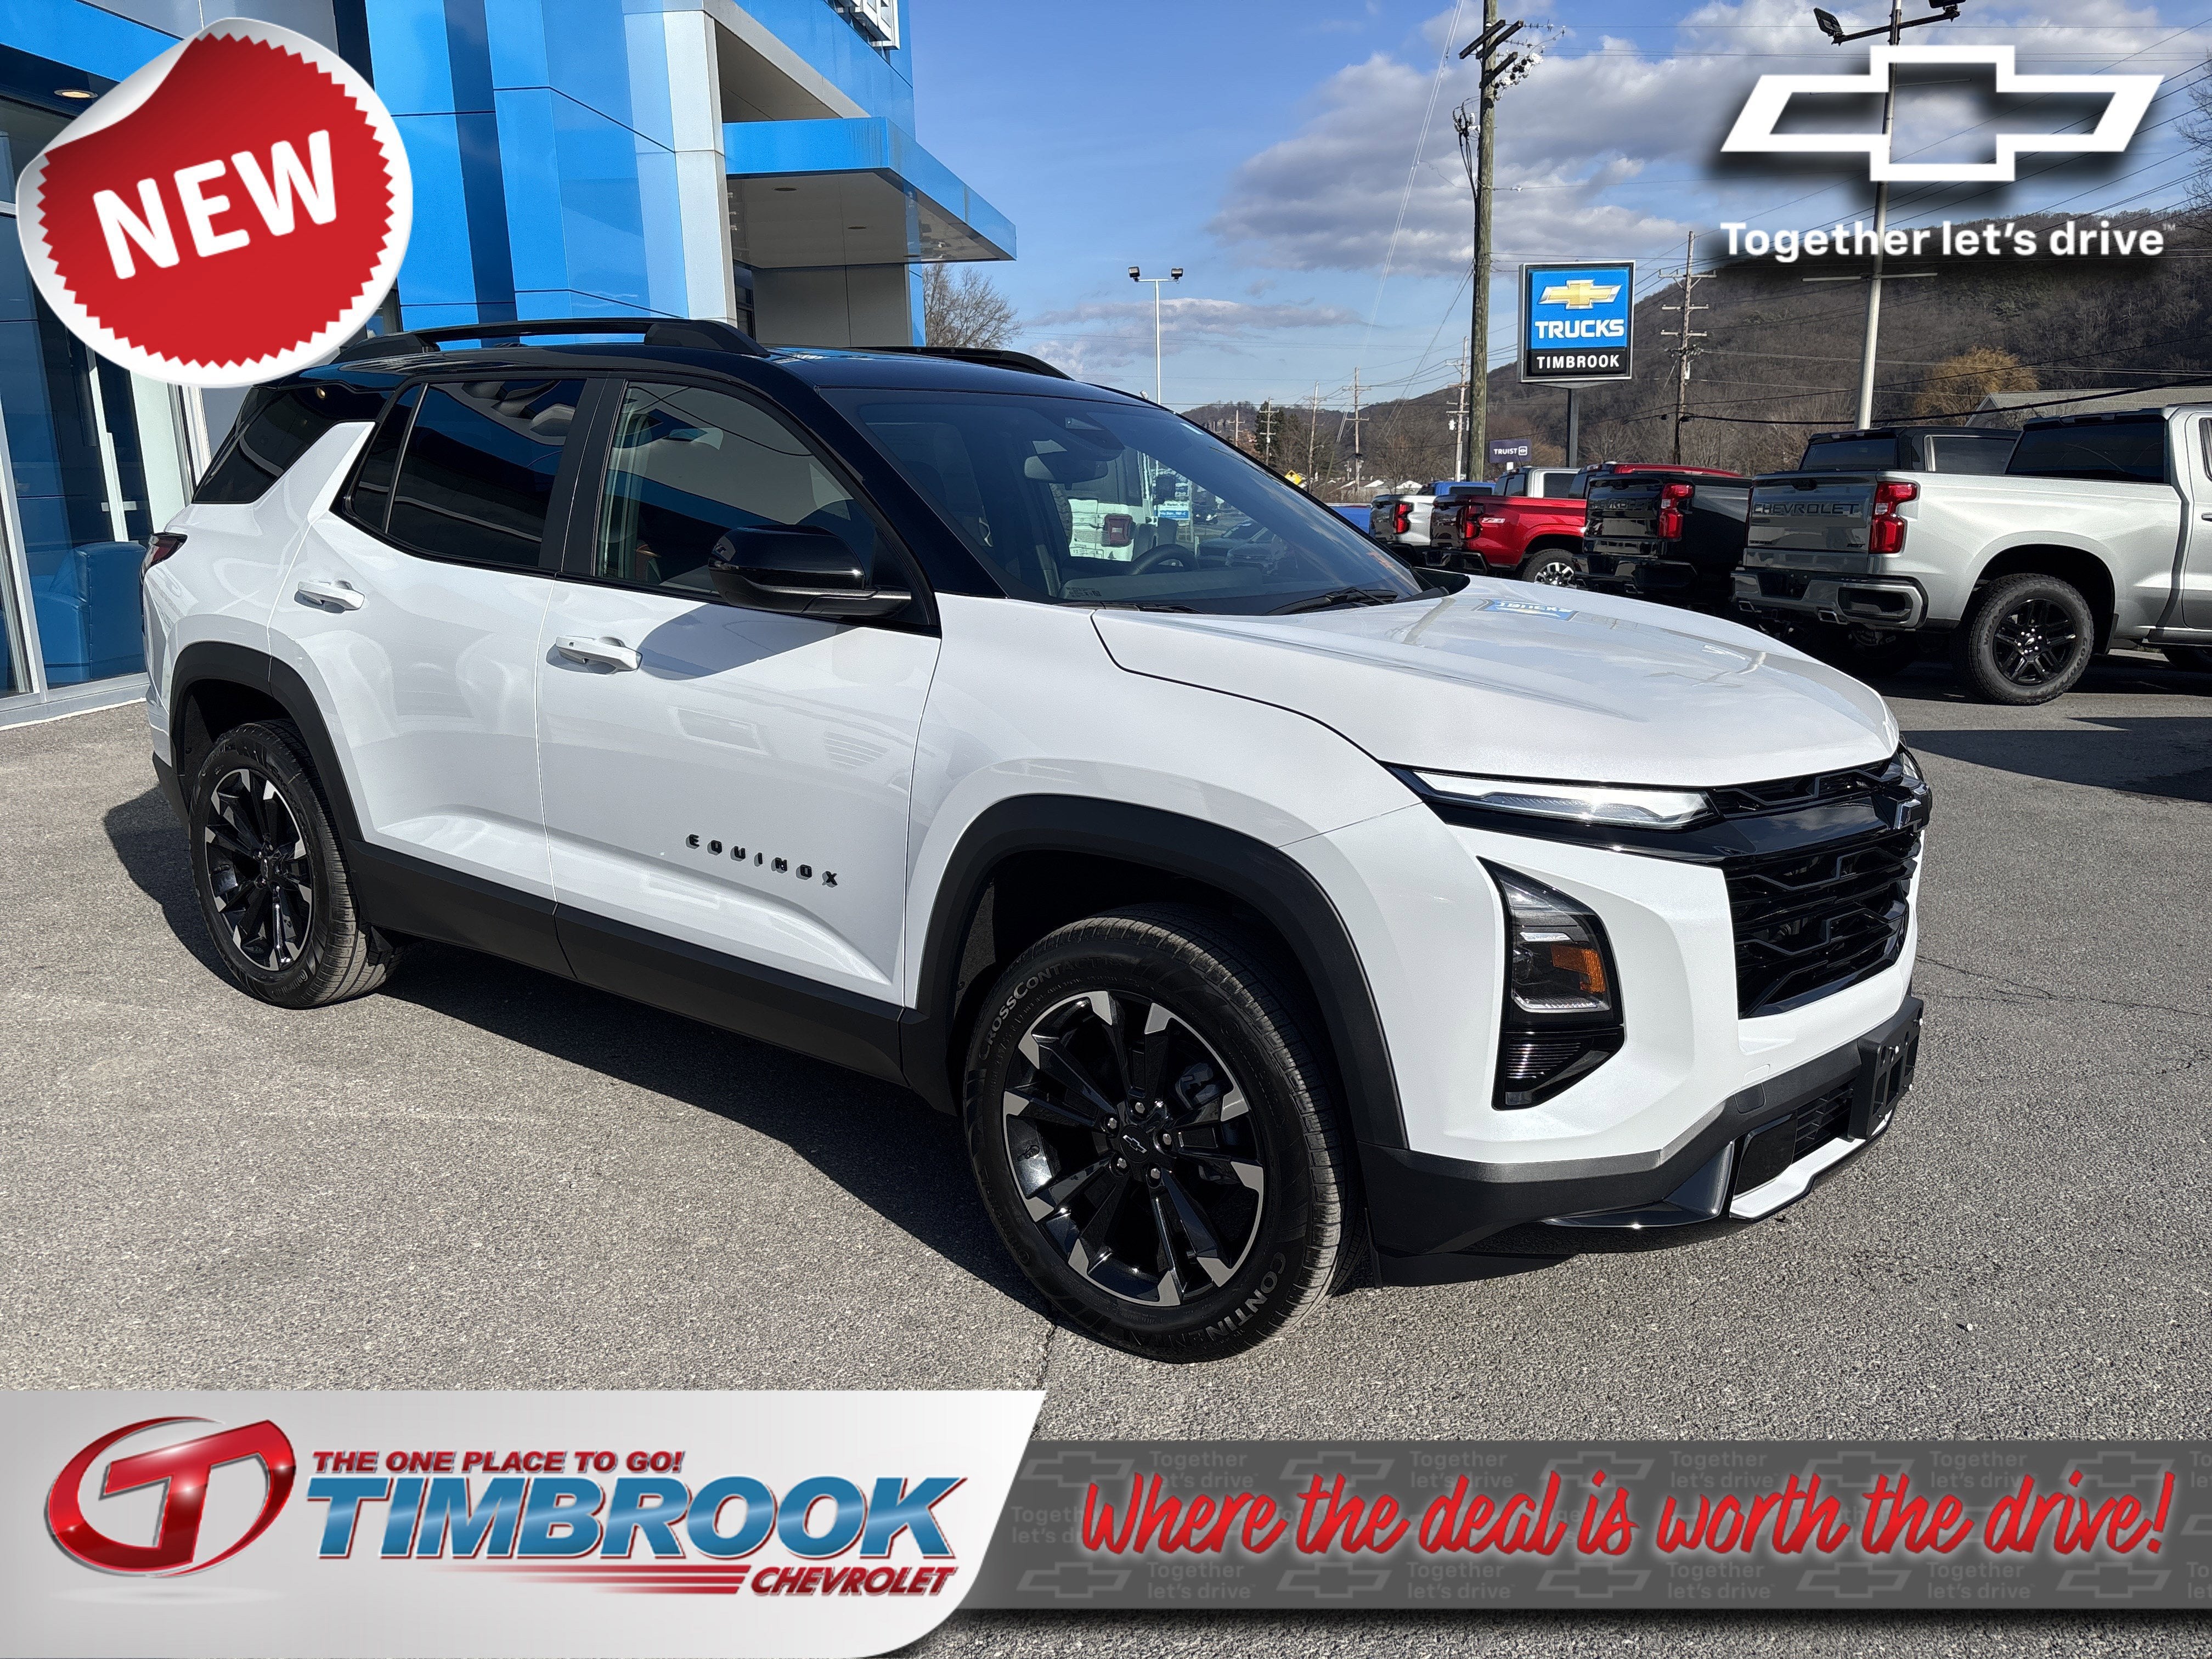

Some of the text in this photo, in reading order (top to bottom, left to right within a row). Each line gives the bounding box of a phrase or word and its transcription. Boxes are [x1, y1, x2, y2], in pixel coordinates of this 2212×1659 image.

[1534, 319, 1624, 338] TRUCKS
[1537, 354, 1620, 369] TIMBROOK
[1753, 503, 1860, 515] CHEVROLET
[685, 834, 838, 888] EQUINOX
